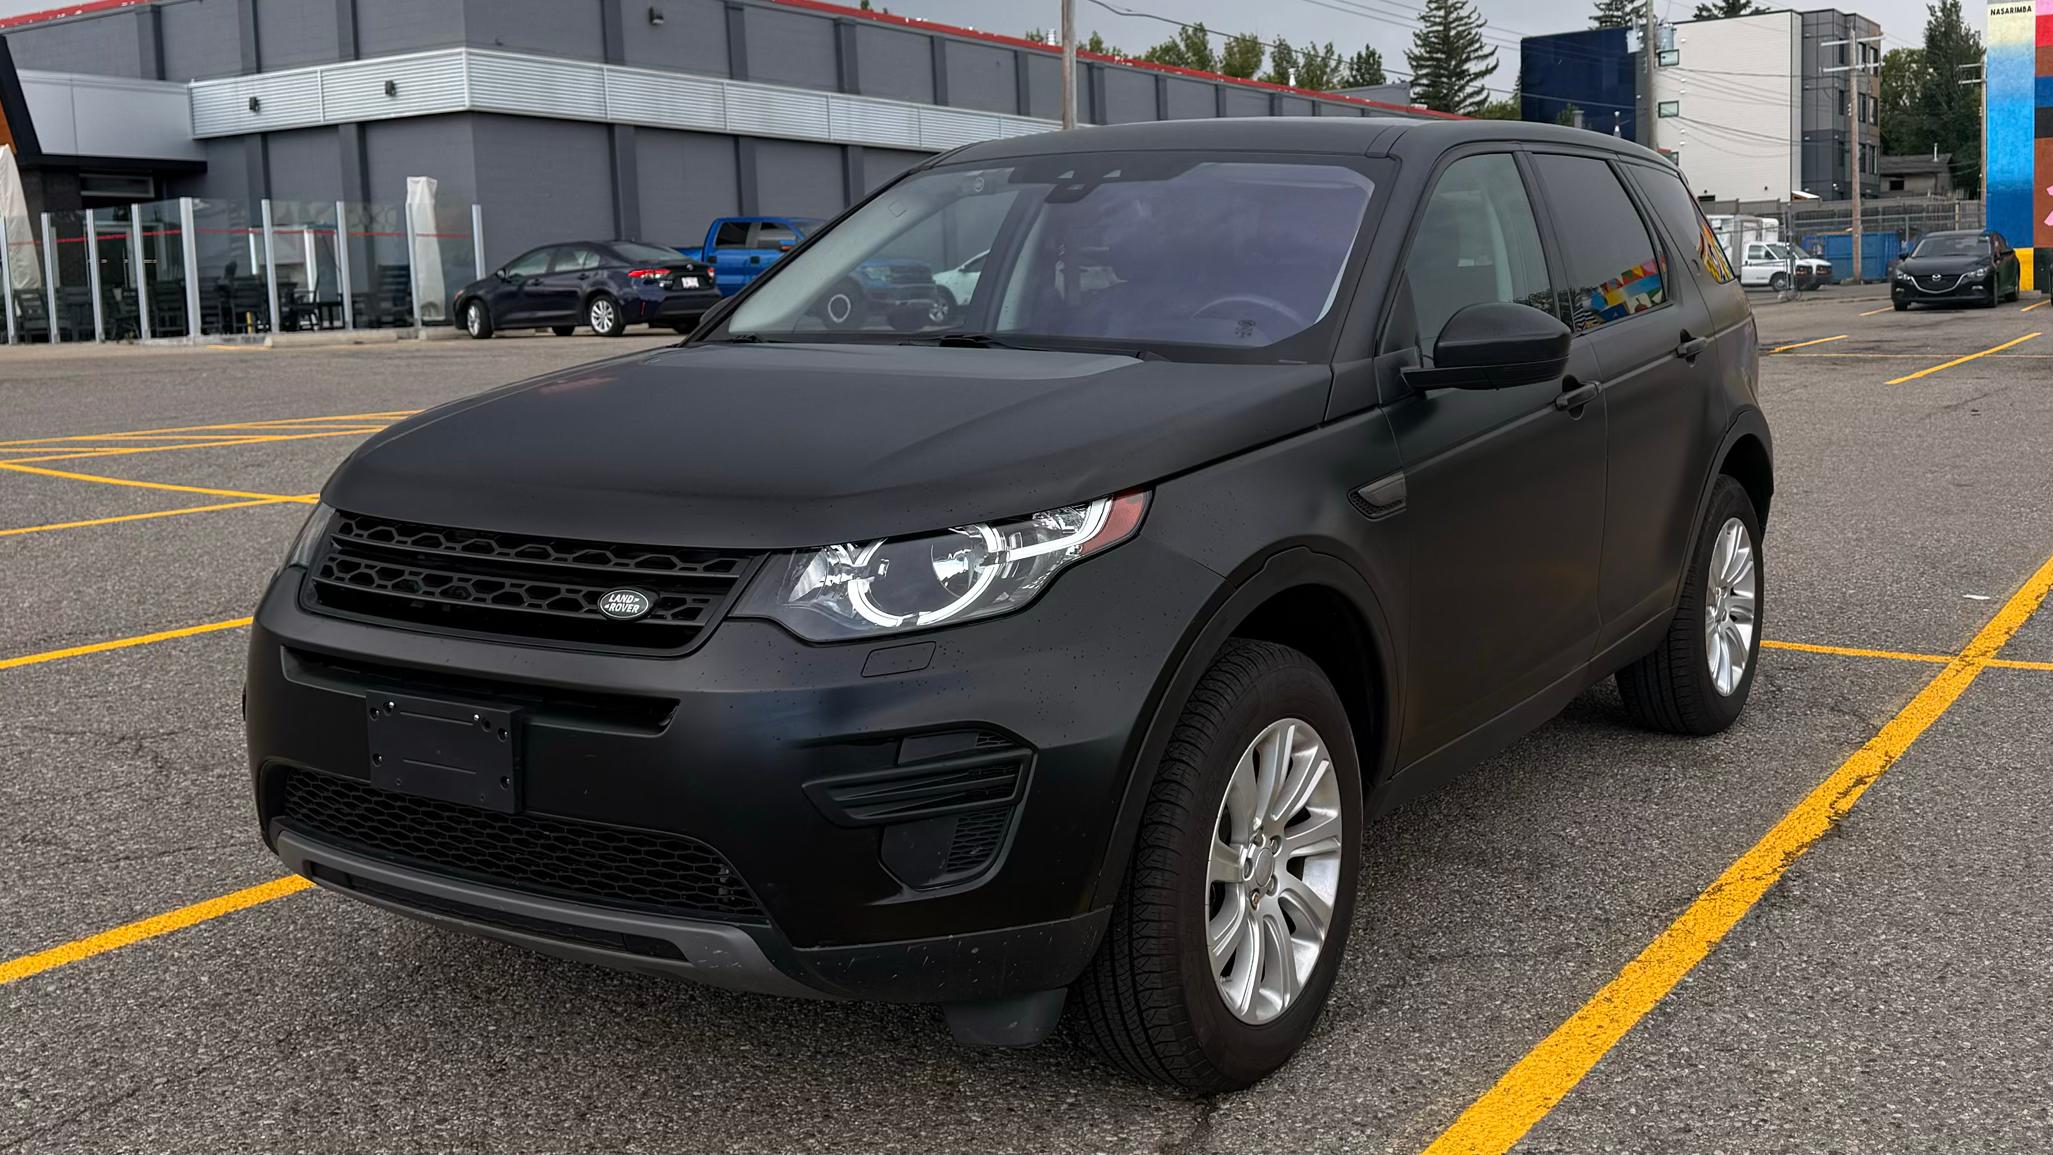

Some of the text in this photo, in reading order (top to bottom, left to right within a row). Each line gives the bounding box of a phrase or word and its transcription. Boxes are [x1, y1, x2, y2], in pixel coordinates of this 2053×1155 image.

[1990, 5, 2031, 15] NASARIMBA
[608, 594, 634, 603] LAND
[609, 603, 639, 613] ROVER
